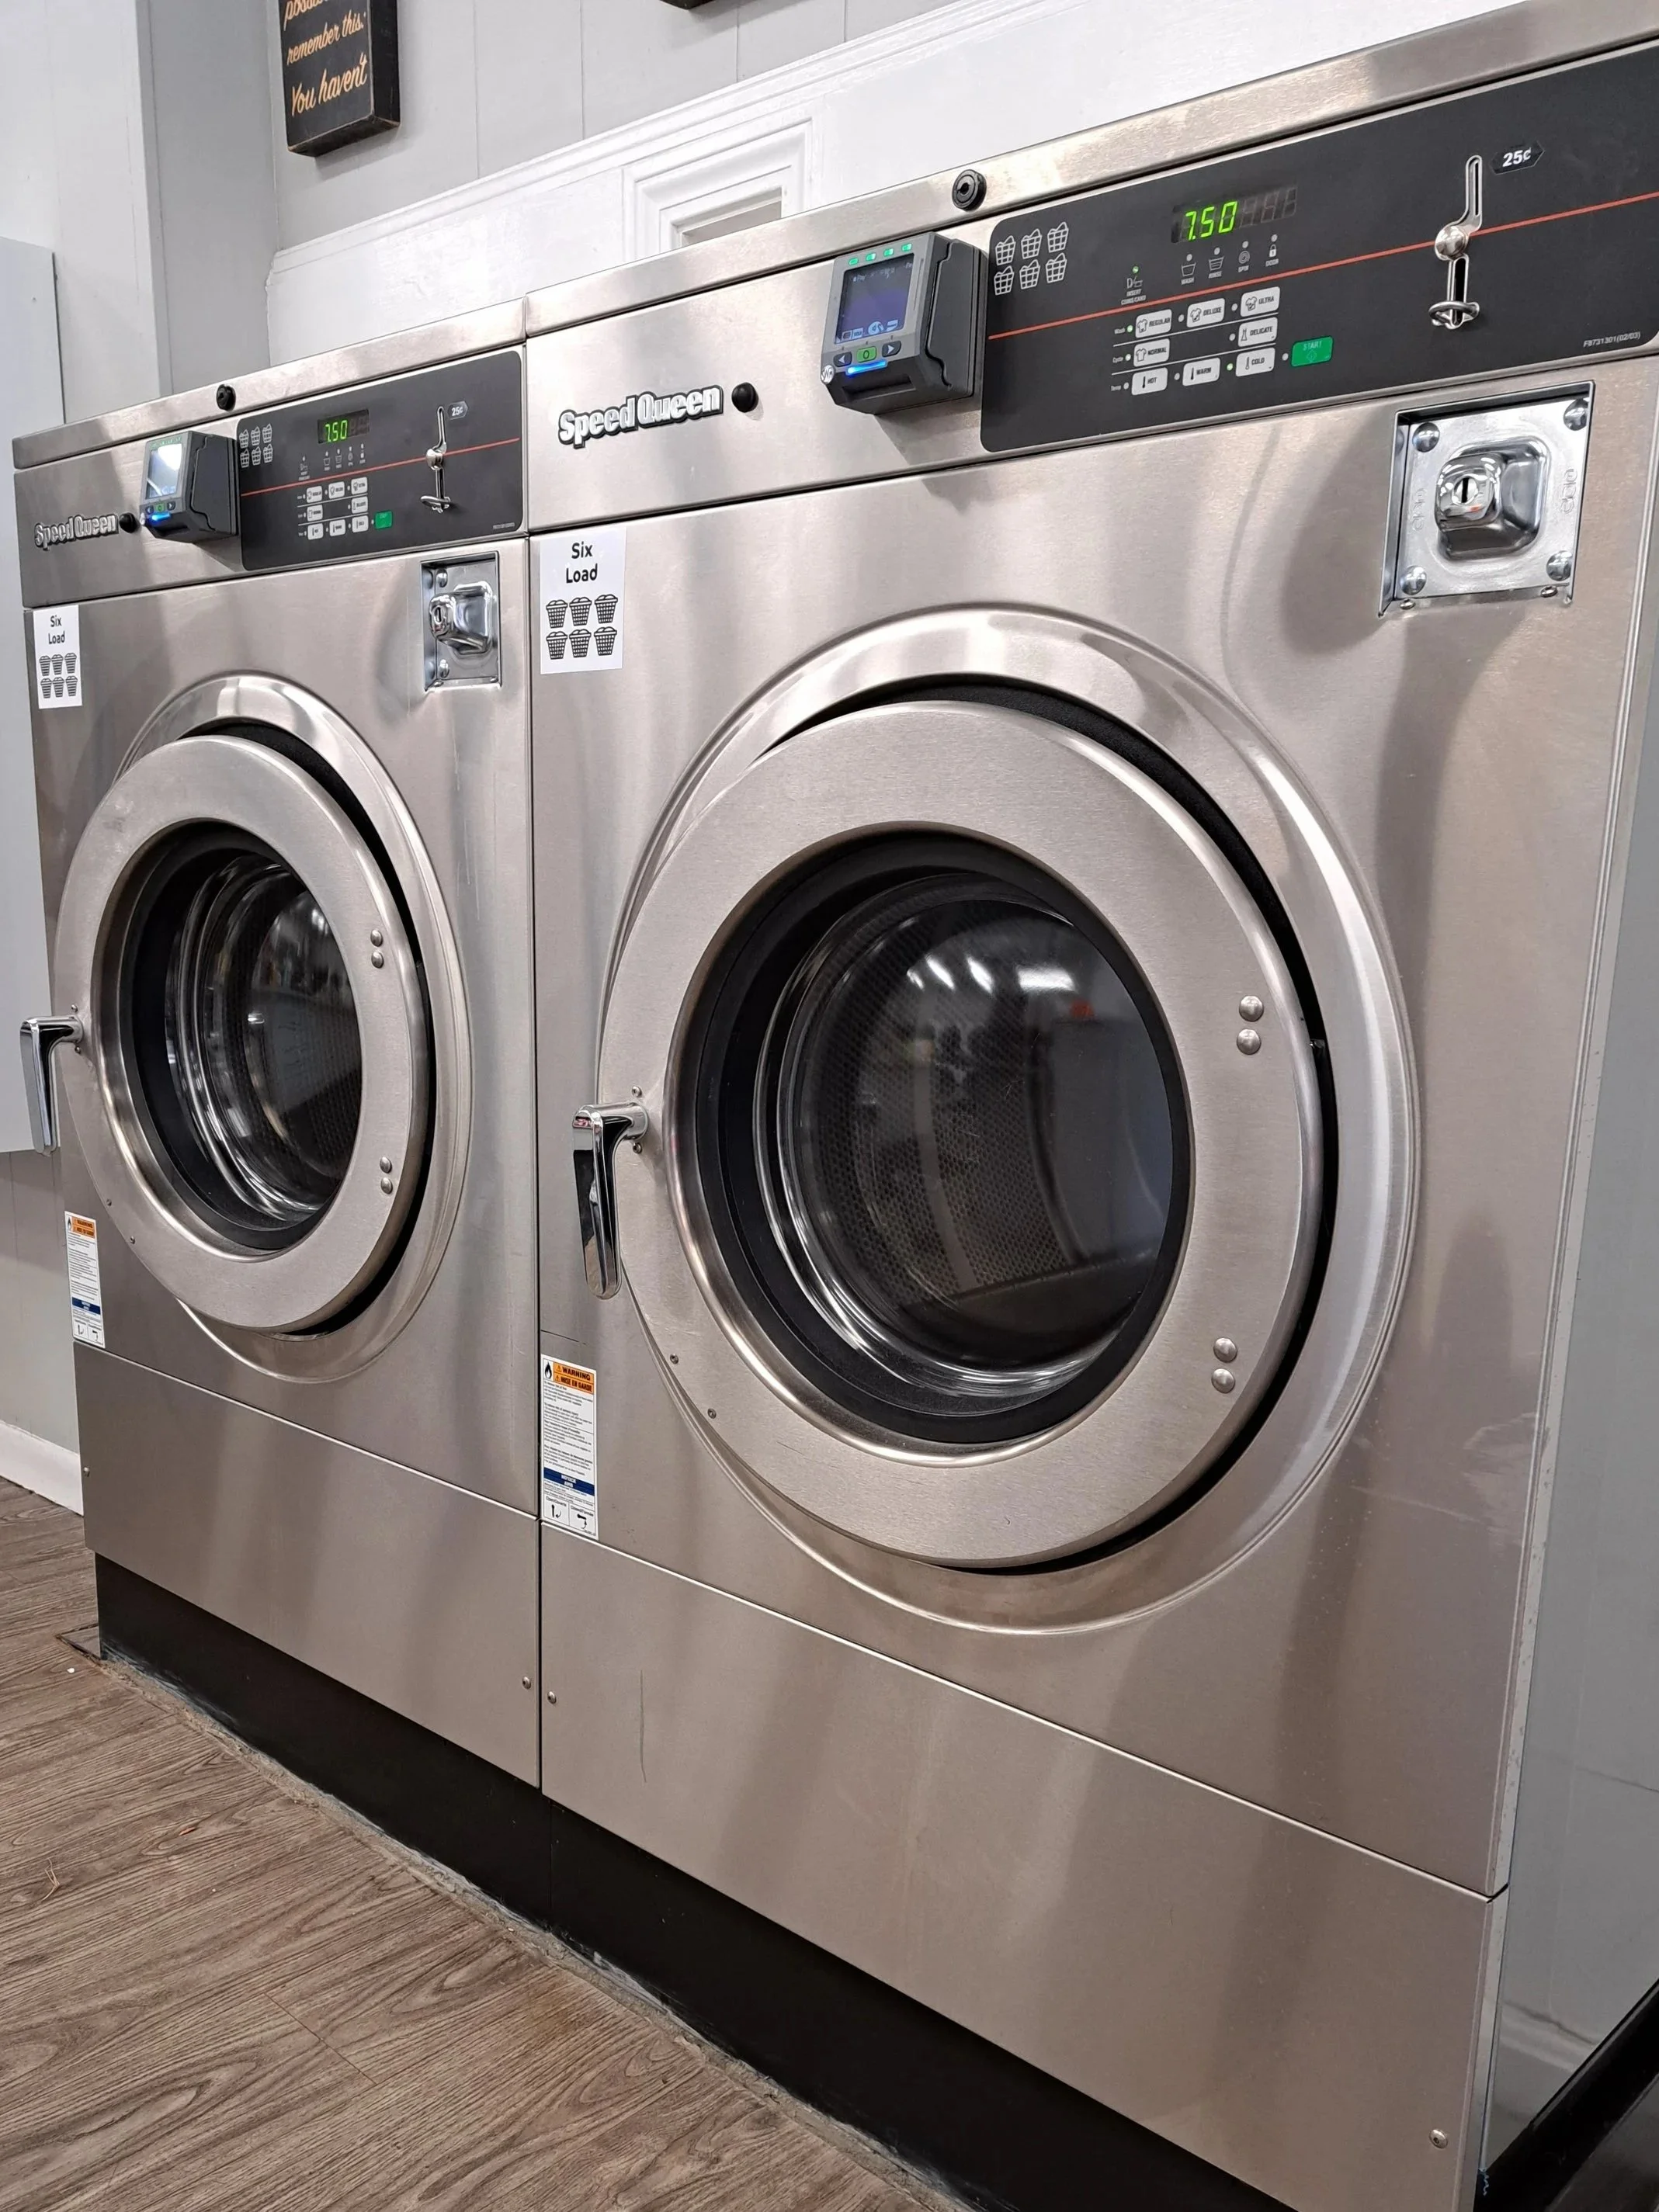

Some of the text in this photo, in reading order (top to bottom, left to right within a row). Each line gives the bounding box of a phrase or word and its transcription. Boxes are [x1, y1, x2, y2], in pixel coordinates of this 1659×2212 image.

[286, 22, 341, 66] remember
[292, 82, 317, 117] You
[1502, 147, 1532, 168] 25¢
[1185, 200, 1238, 241] 7.50
[1258, 296, 1274, 304] ULTRA
[1203, 307, 1222, 316] DELUXE
[1149, 317, 1170, 327] REGULAR
[1250, 326, 1273, 336] DELICATE
[1147, 347, 1167, 355] NORMAL
[1303, 341, 1322, 351] START
[558, 385, 724, 449] Speed Queen
[34, 515, 119, 551] Speed Queen
[571, 541, 593, 560] Six
[566, 563, 598, 584] Load
[50, 615, 62, 627] Six
[48, 630, 65, 644] Load
[562, 1366, 591, 1381] WARNING
